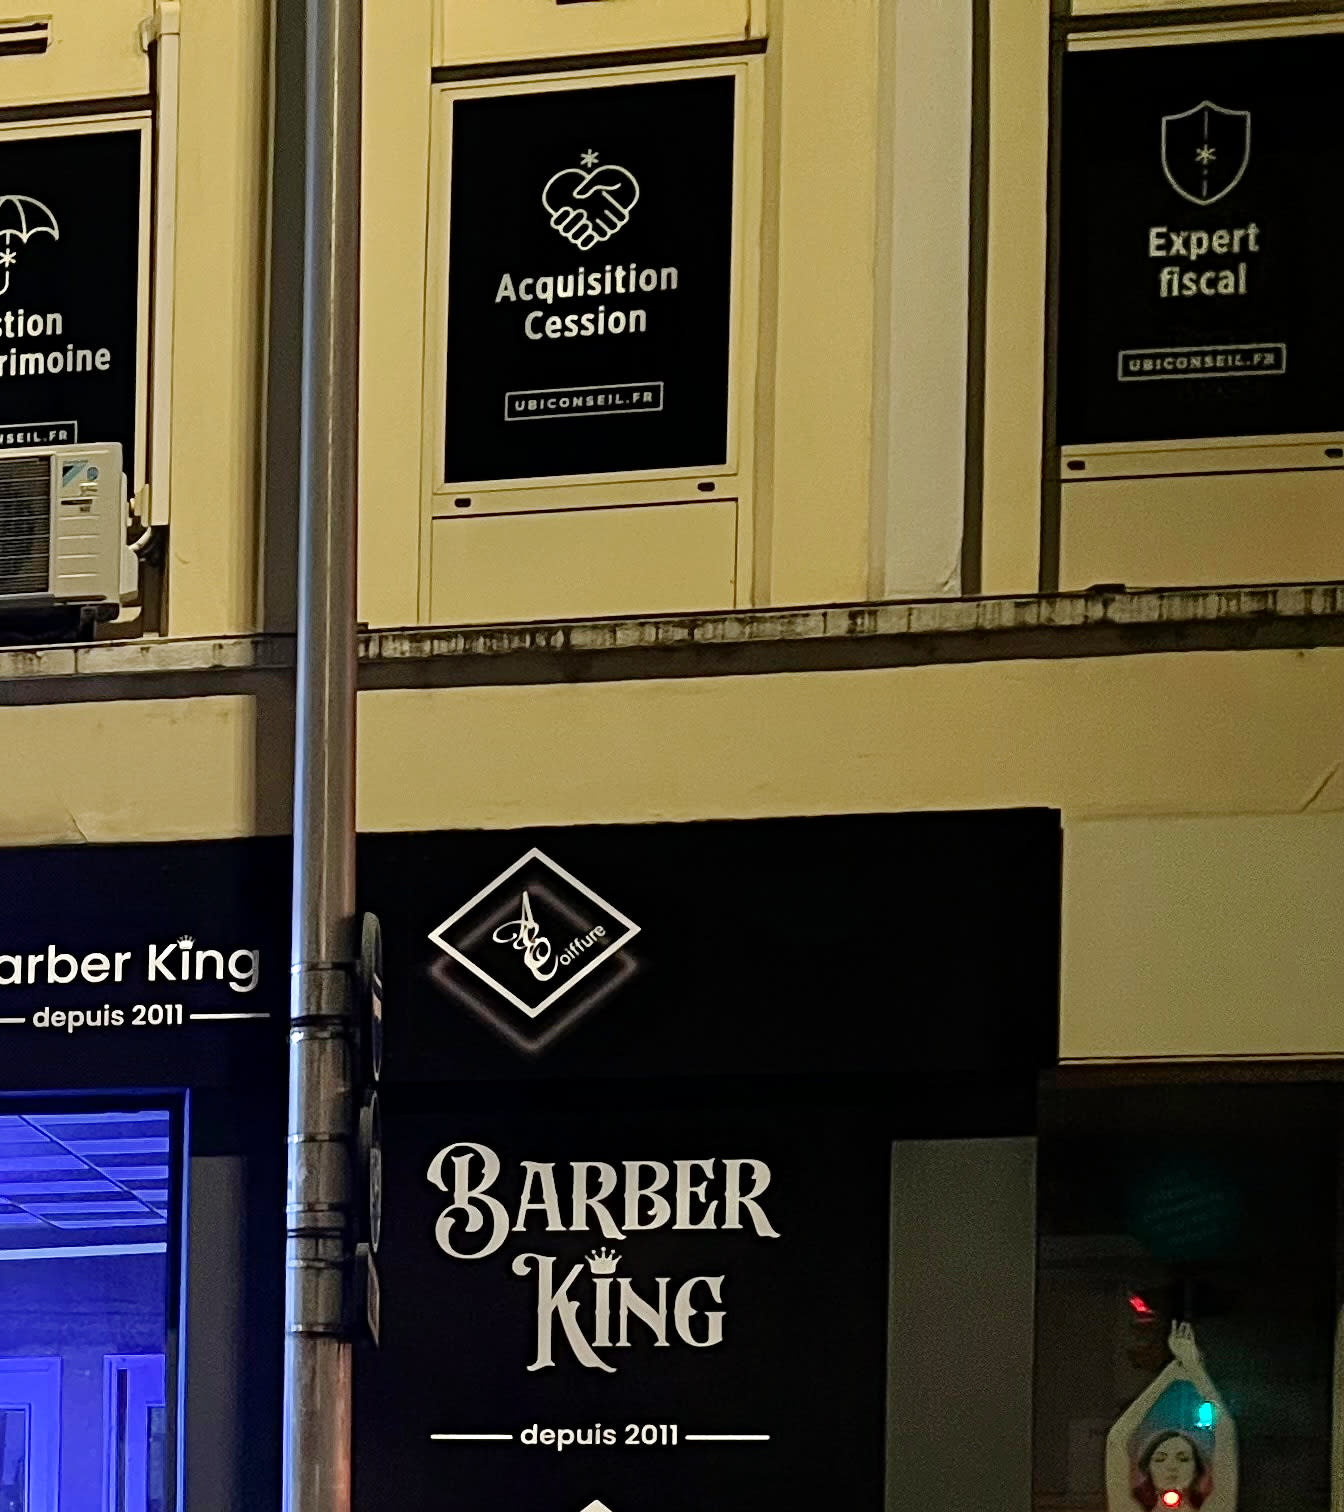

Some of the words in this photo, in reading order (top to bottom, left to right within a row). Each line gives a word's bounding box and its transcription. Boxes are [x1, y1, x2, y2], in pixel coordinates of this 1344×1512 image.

[1148, 222, 1260, 261] Expert
[495, 262, 678, 304] Acquisition
[1159, 262, 1247, 298] fiscal
[524, 305, 647, 340] Cession
[514, 390, 654, 412] UBICONSEIL.FR
[148, 938, 261, 992] King
[32, 1004, 125, 1033] depuis
[131, 1003, 183, 1026] 2011
[426, 1142, 781, 1260] BARBER
[512, 1252, 727, 1374] KING
[520, 1422, 617, 1452] depuis
[624, 1423, 678, 1446] 2011
